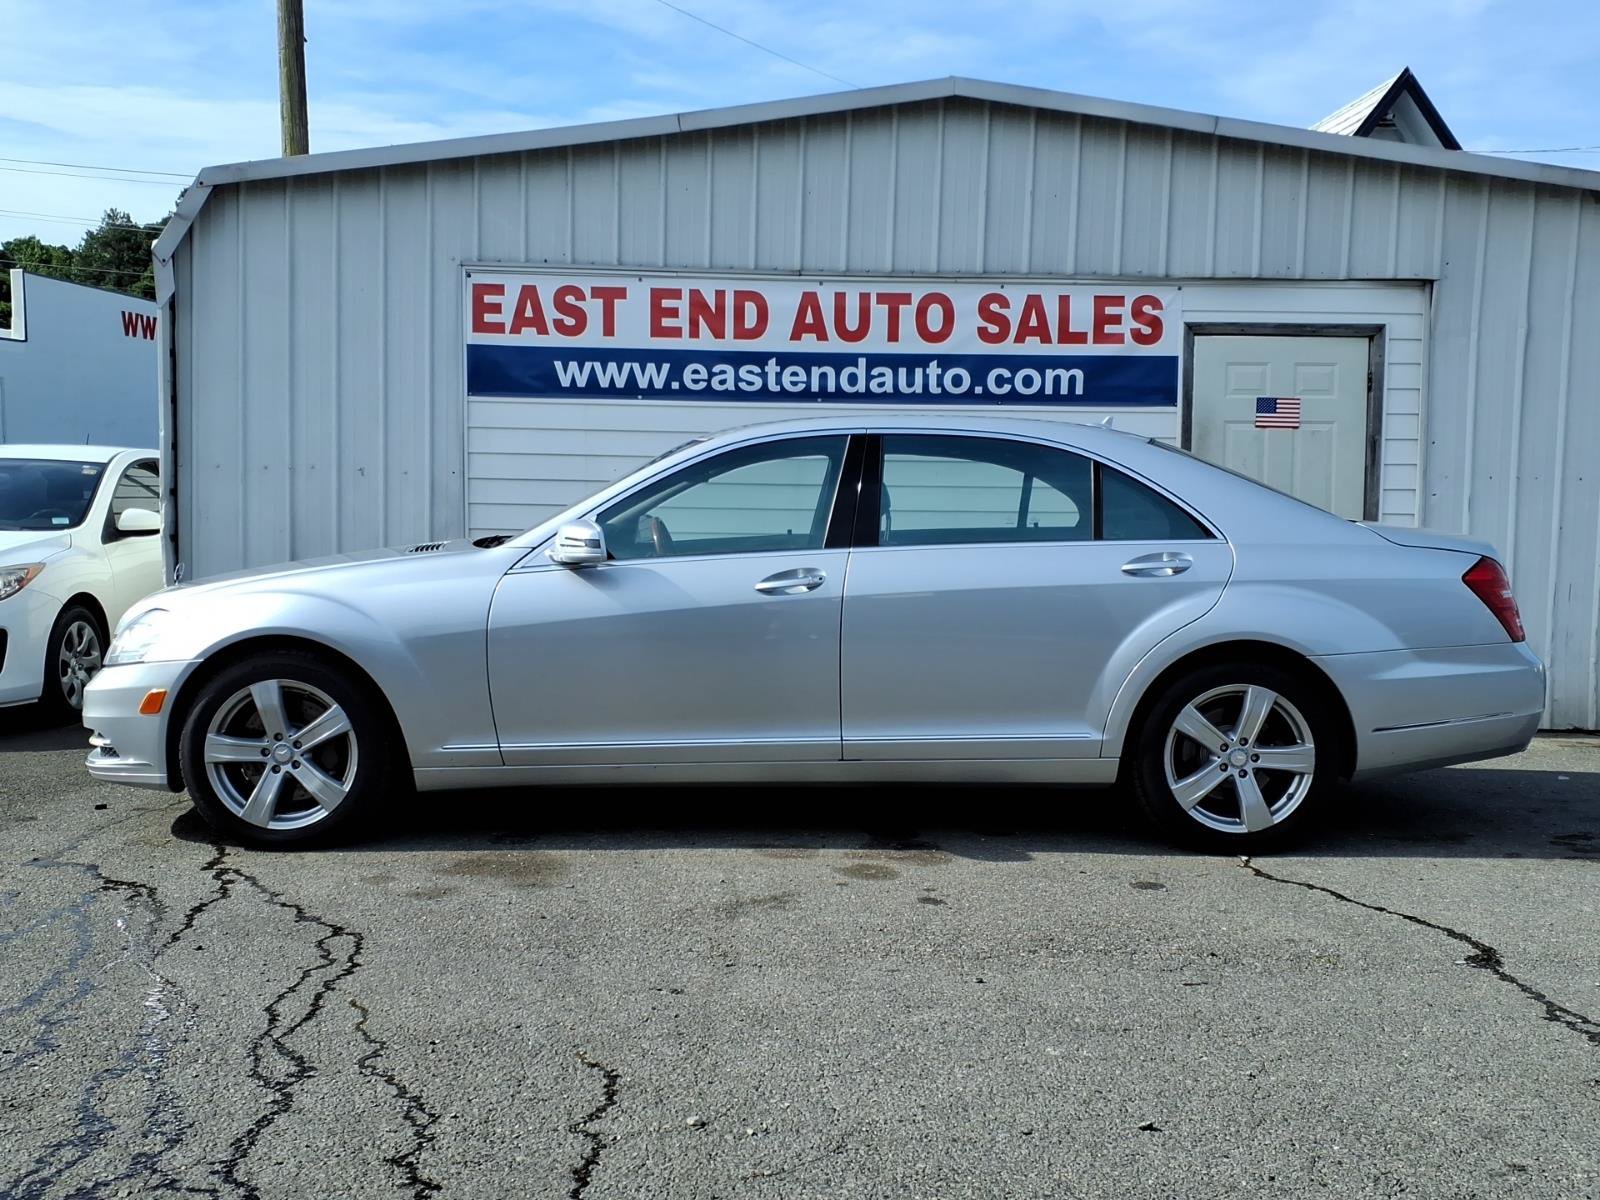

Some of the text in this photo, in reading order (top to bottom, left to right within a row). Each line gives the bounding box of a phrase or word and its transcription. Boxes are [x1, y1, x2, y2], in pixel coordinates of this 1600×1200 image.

[472, 283, 1164, 346] EAST END AUTO SALES
[553, 357, 1084, 396] www.eastendauto.com
